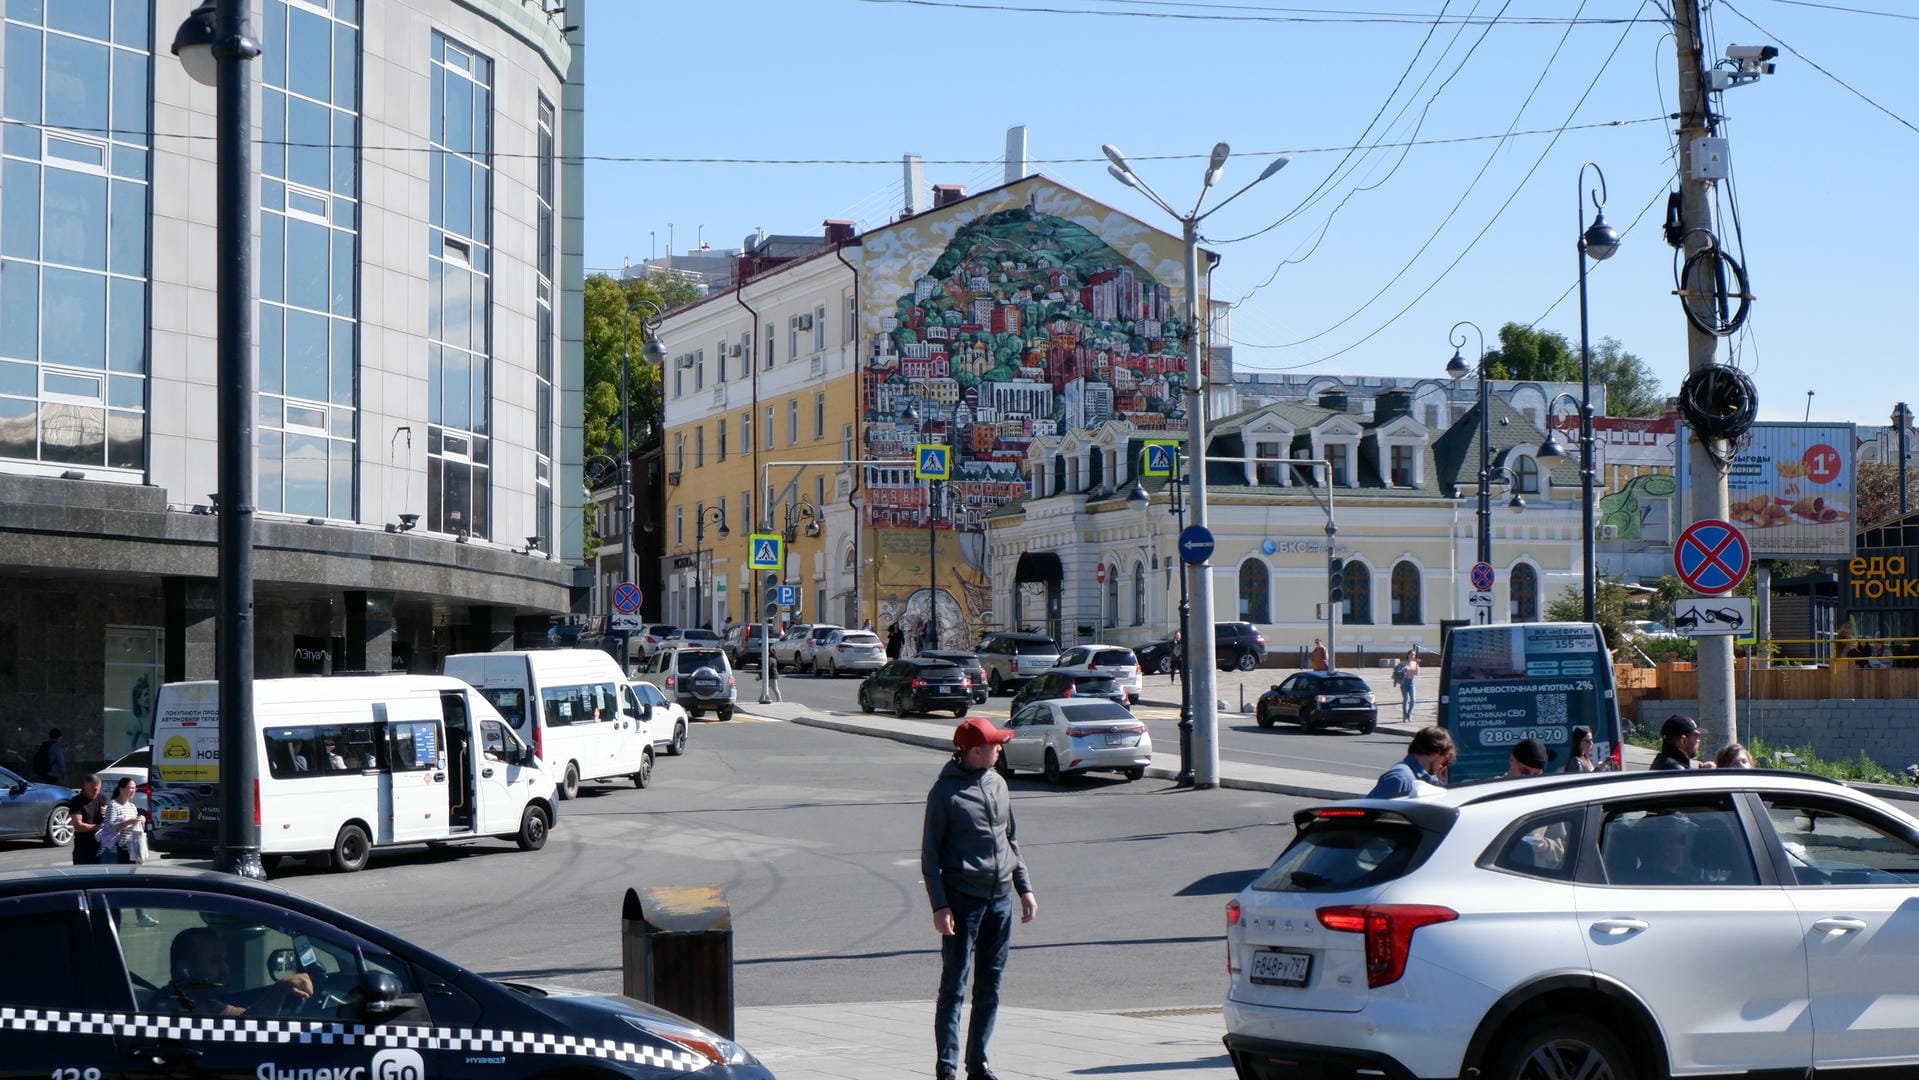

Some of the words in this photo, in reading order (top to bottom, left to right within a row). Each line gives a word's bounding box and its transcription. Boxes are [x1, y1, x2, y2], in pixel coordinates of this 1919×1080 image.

[1849, 556, 1905, 579] еда
[1850, 579, 1919, 598] точк
[1556, 640, 1575, 649] 155
[1458, 685, 1538, 695] ДАЛЬНЕВОСТОЧНАЯ
[1538, 683, 1575, 692] ИПОТЕКА
[1576, 680, 1594, 691] 2%
[1459, 711, 1507, 719] УЧАСТНИКАМ
[1507, 709, 1526, 718] СВО
[1485, 729, 1562, 743] 280-40-70
[378, 1059, 418, 1080] Go
